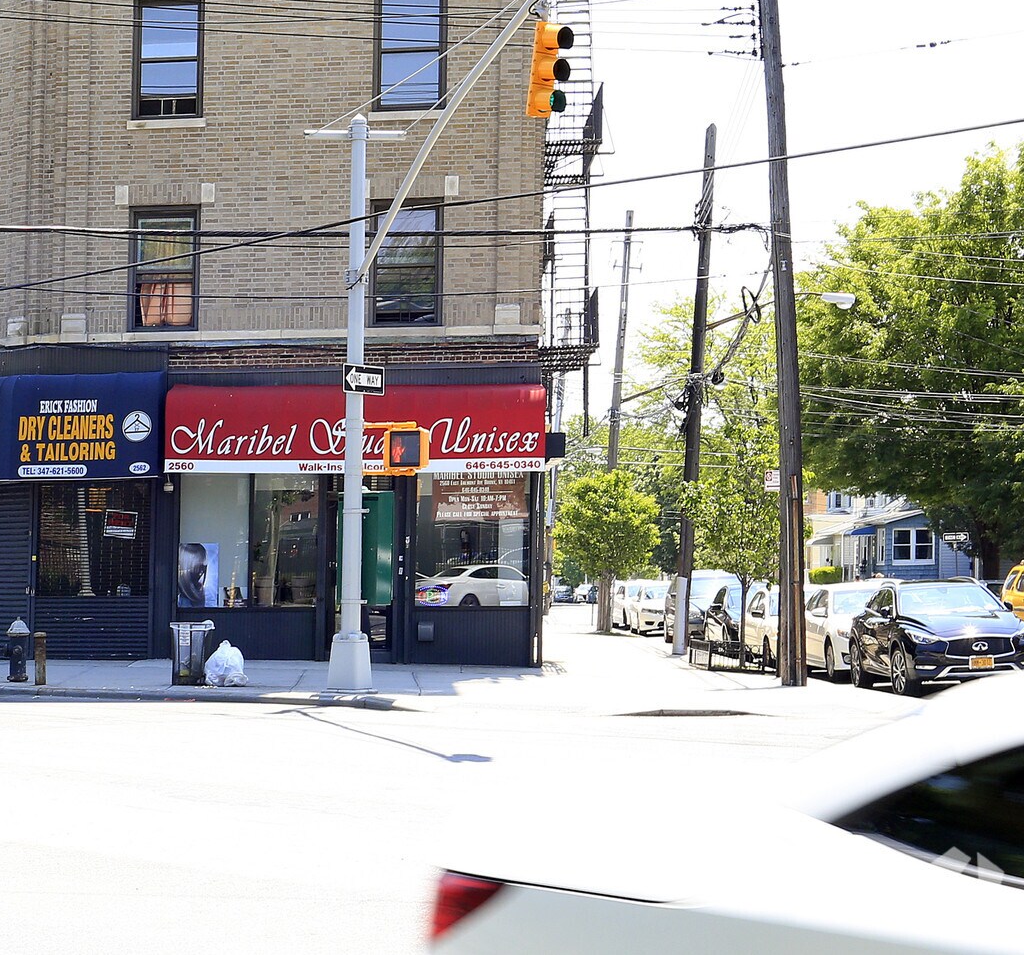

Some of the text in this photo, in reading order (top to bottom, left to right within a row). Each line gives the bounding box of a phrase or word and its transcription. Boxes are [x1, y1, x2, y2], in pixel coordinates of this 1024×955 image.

[350, 373, 379, 386] ONE WAY
[40, 399, 98, 414] ERICK FASHION
[18, 414, 114, 440] DRY CLEANERS
[170, 418, 298, 455] Maribel
[430, 416, 540, 454] Unisex
[20, 441, 116, 462] & TAILORING
[38, 466, 84, 475] 347-621-5600
[168, 462, 194, 470] 2560
[298, 462, 342, 472] Walk-Ins
[466, 460, 541, 470] 646-645-0340
